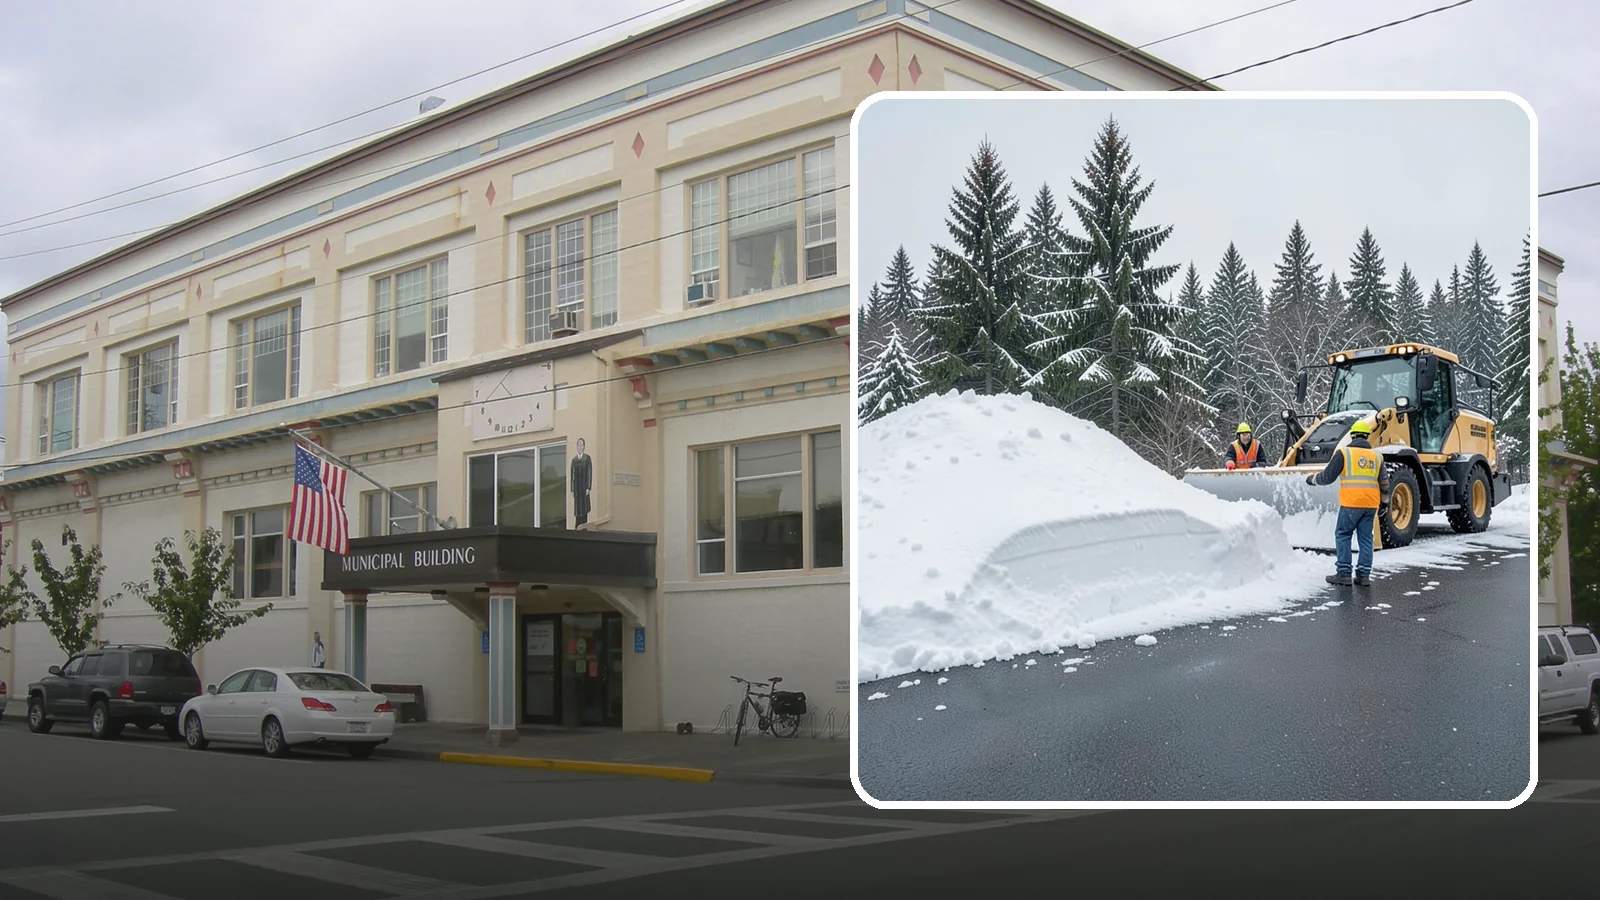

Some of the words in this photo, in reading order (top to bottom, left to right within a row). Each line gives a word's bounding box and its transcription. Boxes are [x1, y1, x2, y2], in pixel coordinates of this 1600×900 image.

[529, 414, 533, 422] 3
[342, 552, 405, 572] MUNICIPAL
[414, 546, 475, 567] BUILDING
